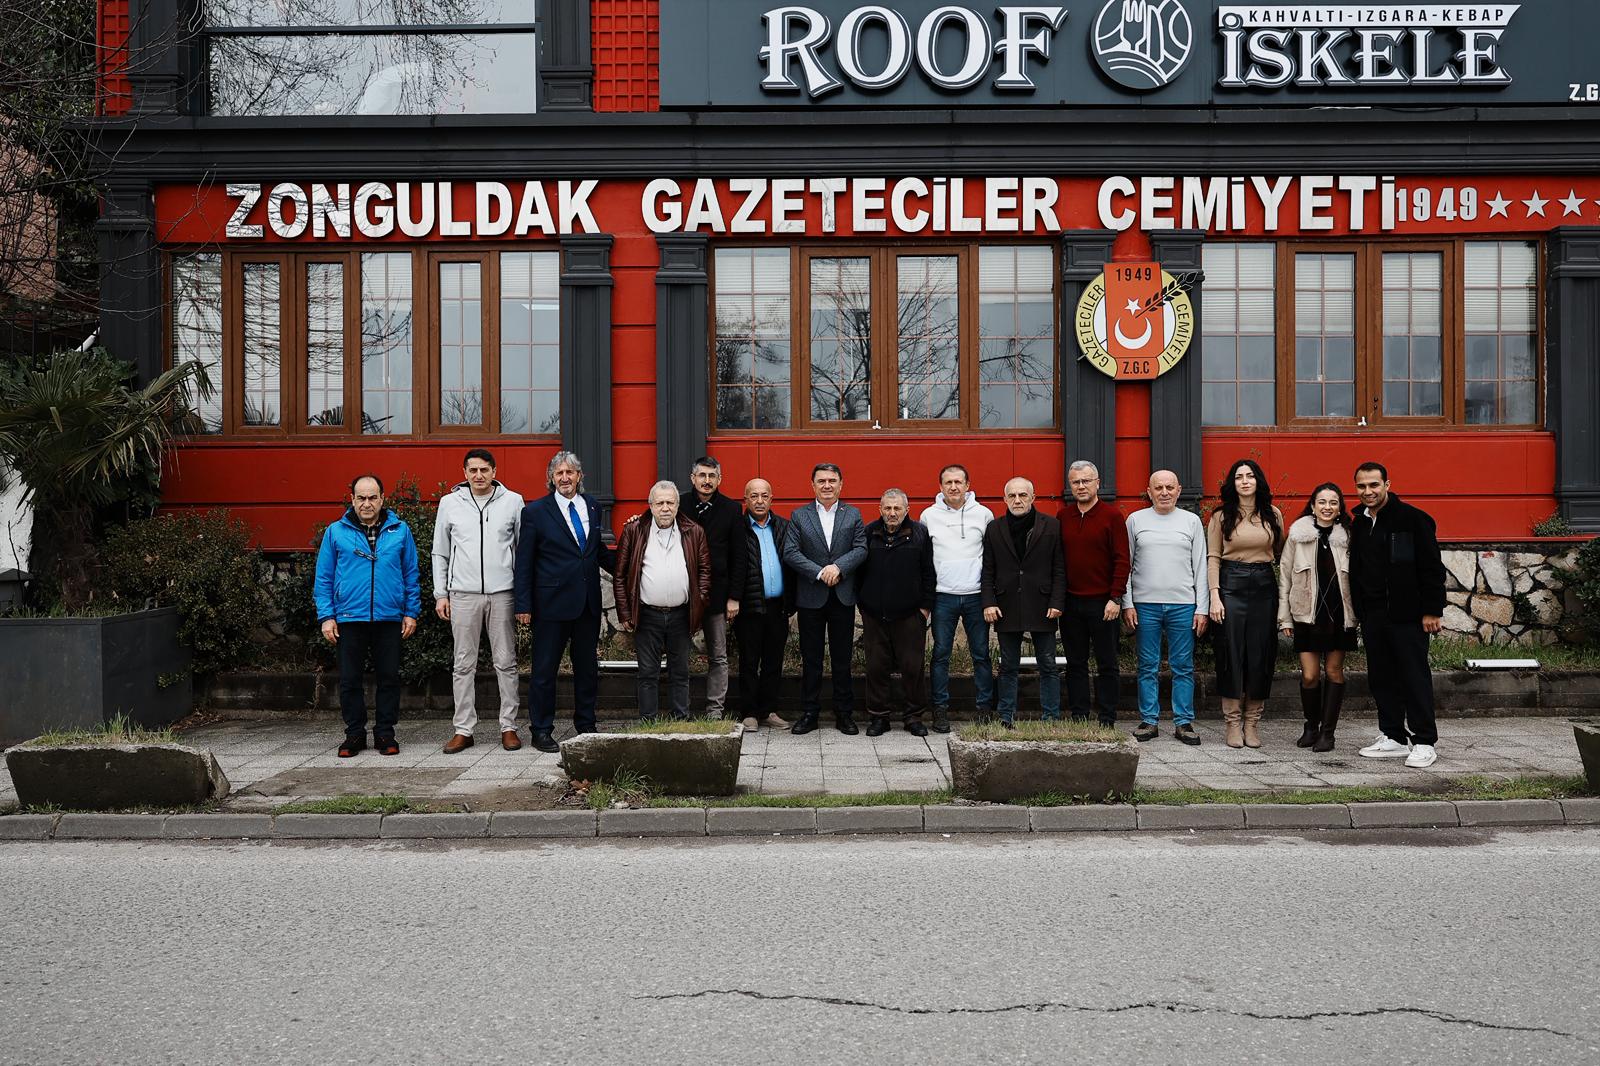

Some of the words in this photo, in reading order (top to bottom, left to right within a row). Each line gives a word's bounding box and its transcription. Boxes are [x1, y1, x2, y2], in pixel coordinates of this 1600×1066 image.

[758, 4, 1069, 98] ROOF
[1218, 12, 1513, 87] İSKELE
[1569, 83, 1600, 101] Z.G
[225, 179, 601, 239] ZONGULDAK
[1396, 186, 1478, 223] 1949
[1116, 267, 1152, 281] 1949
[1079, 284, 1109, 368] GAZETECİLER
[1162, 303, 1190, 367] CEMİYETİ
[1123, 361, 1150, 374] Z.G.C
